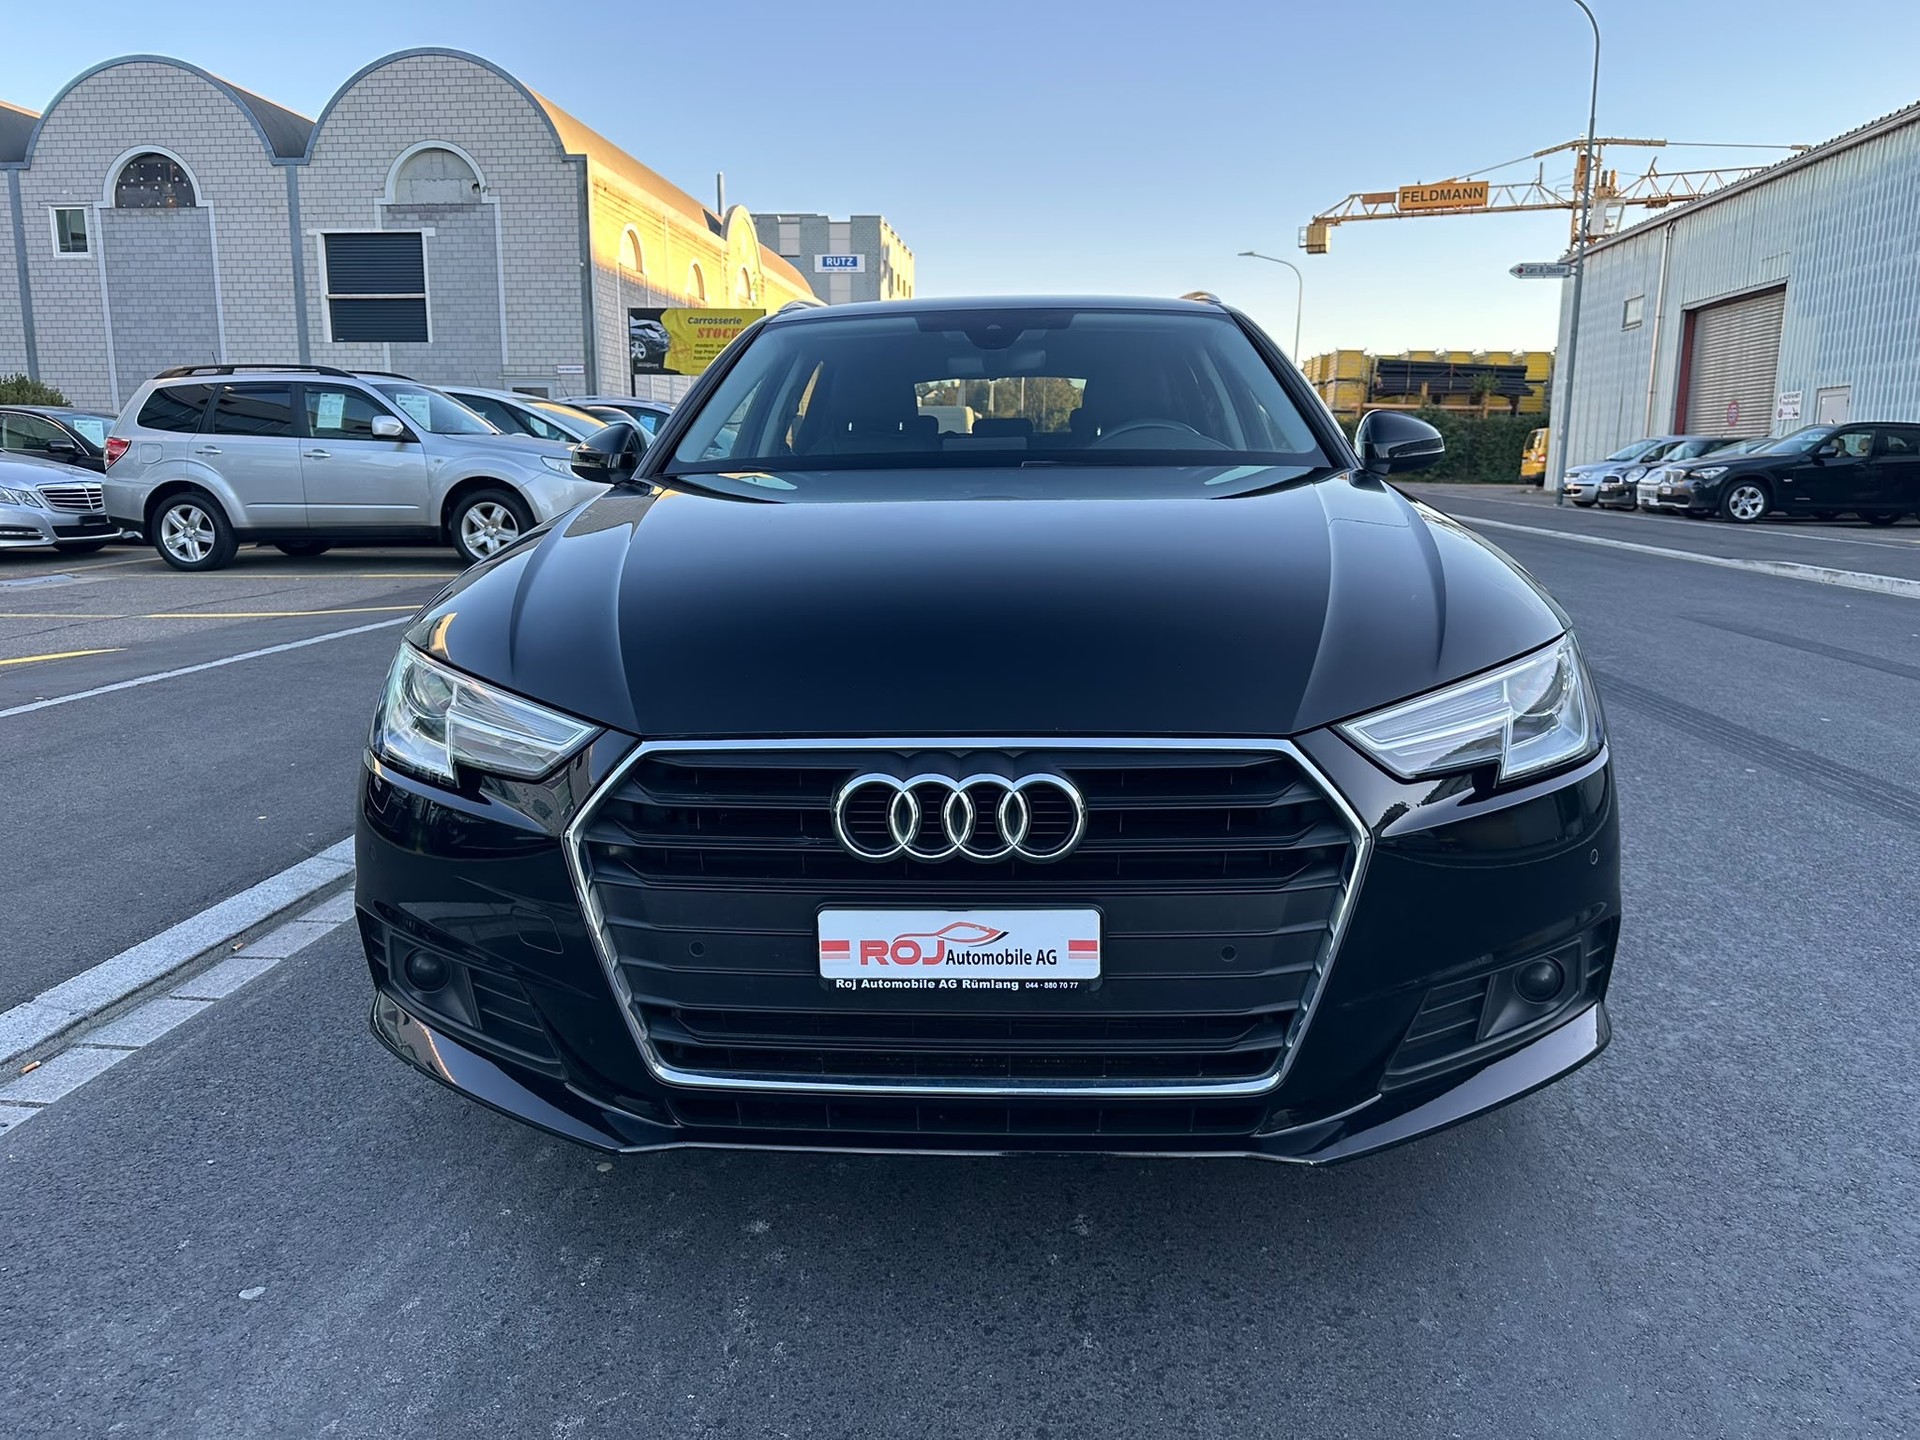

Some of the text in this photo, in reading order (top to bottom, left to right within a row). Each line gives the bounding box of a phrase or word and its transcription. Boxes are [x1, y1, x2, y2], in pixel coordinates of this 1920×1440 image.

[1402, 187, 1484, 203] FELDMANN
[826, 257, 854, 266] RUTZ
[687, 316, 742, 325] Carrosserie
[859, 939, 1057, 966] ROJ Automobile AG
[836, 979, 857, 990] Roj
[861, 979, 935, 989] Automobile
[939, 979, 958, 989] AG
[962, 979, 1019, 990] Rümlang
